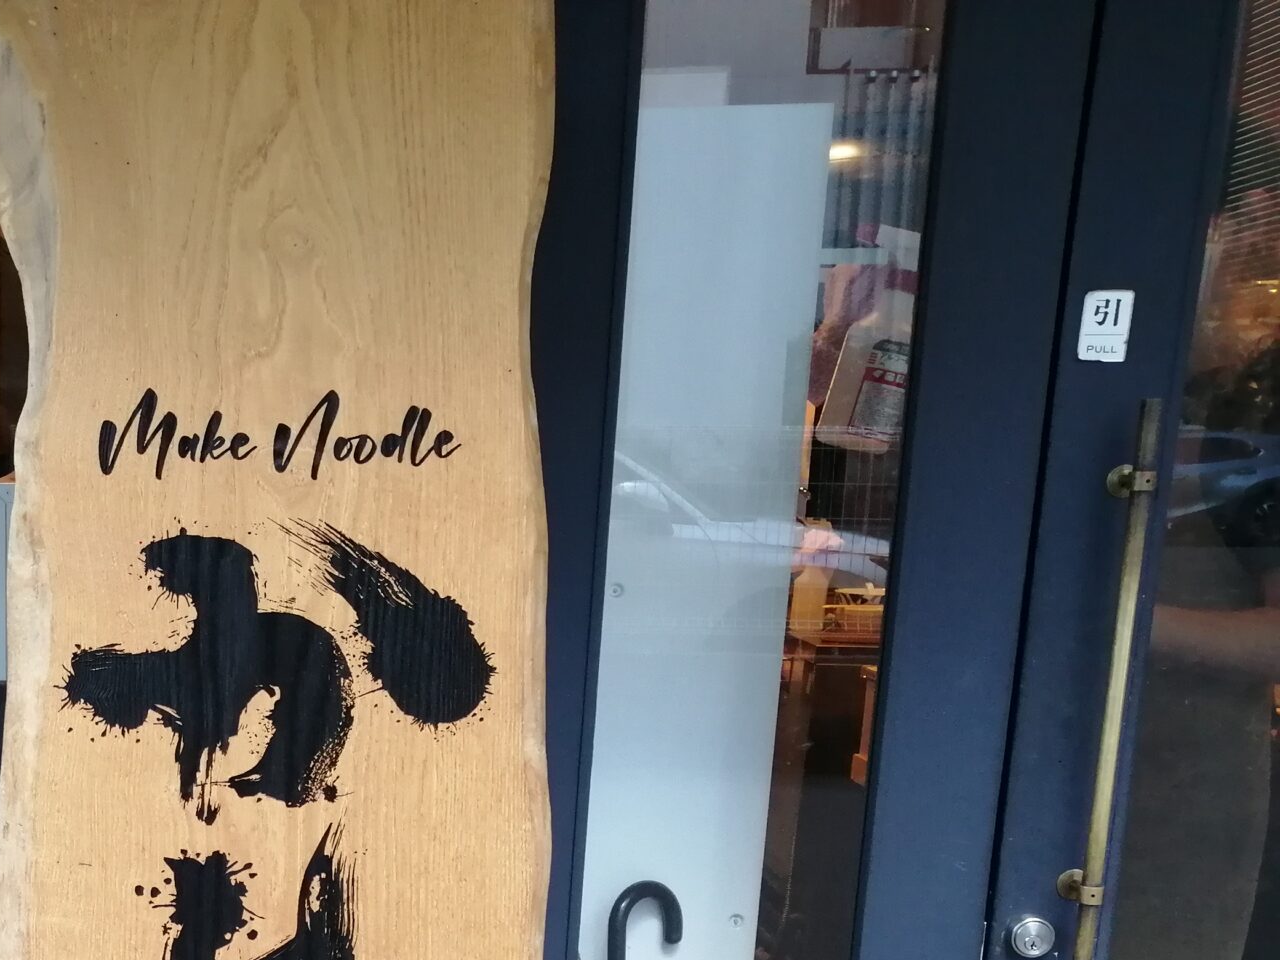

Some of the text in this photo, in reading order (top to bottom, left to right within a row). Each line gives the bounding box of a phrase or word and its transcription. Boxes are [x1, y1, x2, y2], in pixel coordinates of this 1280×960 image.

[1093, 298, 1123, 328] 引
[1085, 344, 1118, 354] PULL
[98, 386, 463, 481] Make Noodle
